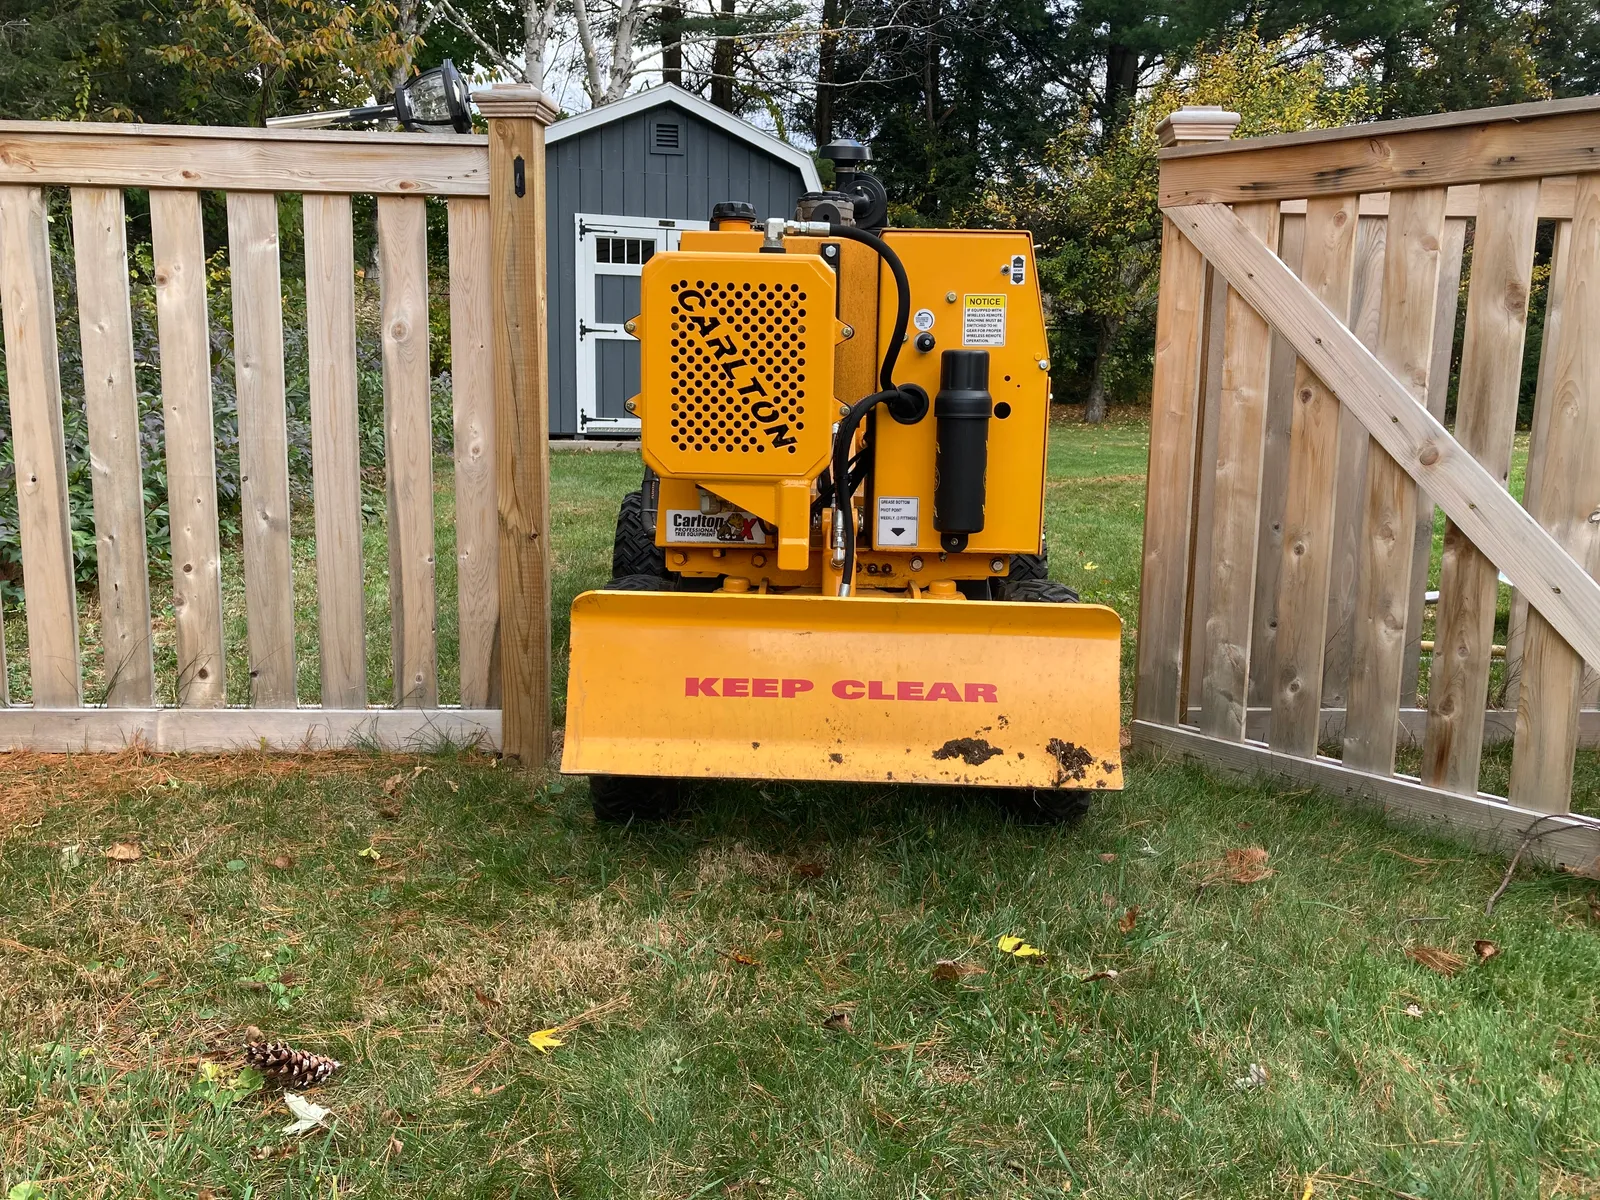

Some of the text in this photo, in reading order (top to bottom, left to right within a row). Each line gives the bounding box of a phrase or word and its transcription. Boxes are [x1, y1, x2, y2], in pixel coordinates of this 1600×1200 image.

[969, 298, 1001, 306] NOTICE
[677, 289, 798, 449] CARLTON
[673, 513, 724, 528] Carlton
[685, 677, 998, 703] KEEP CLEAR
